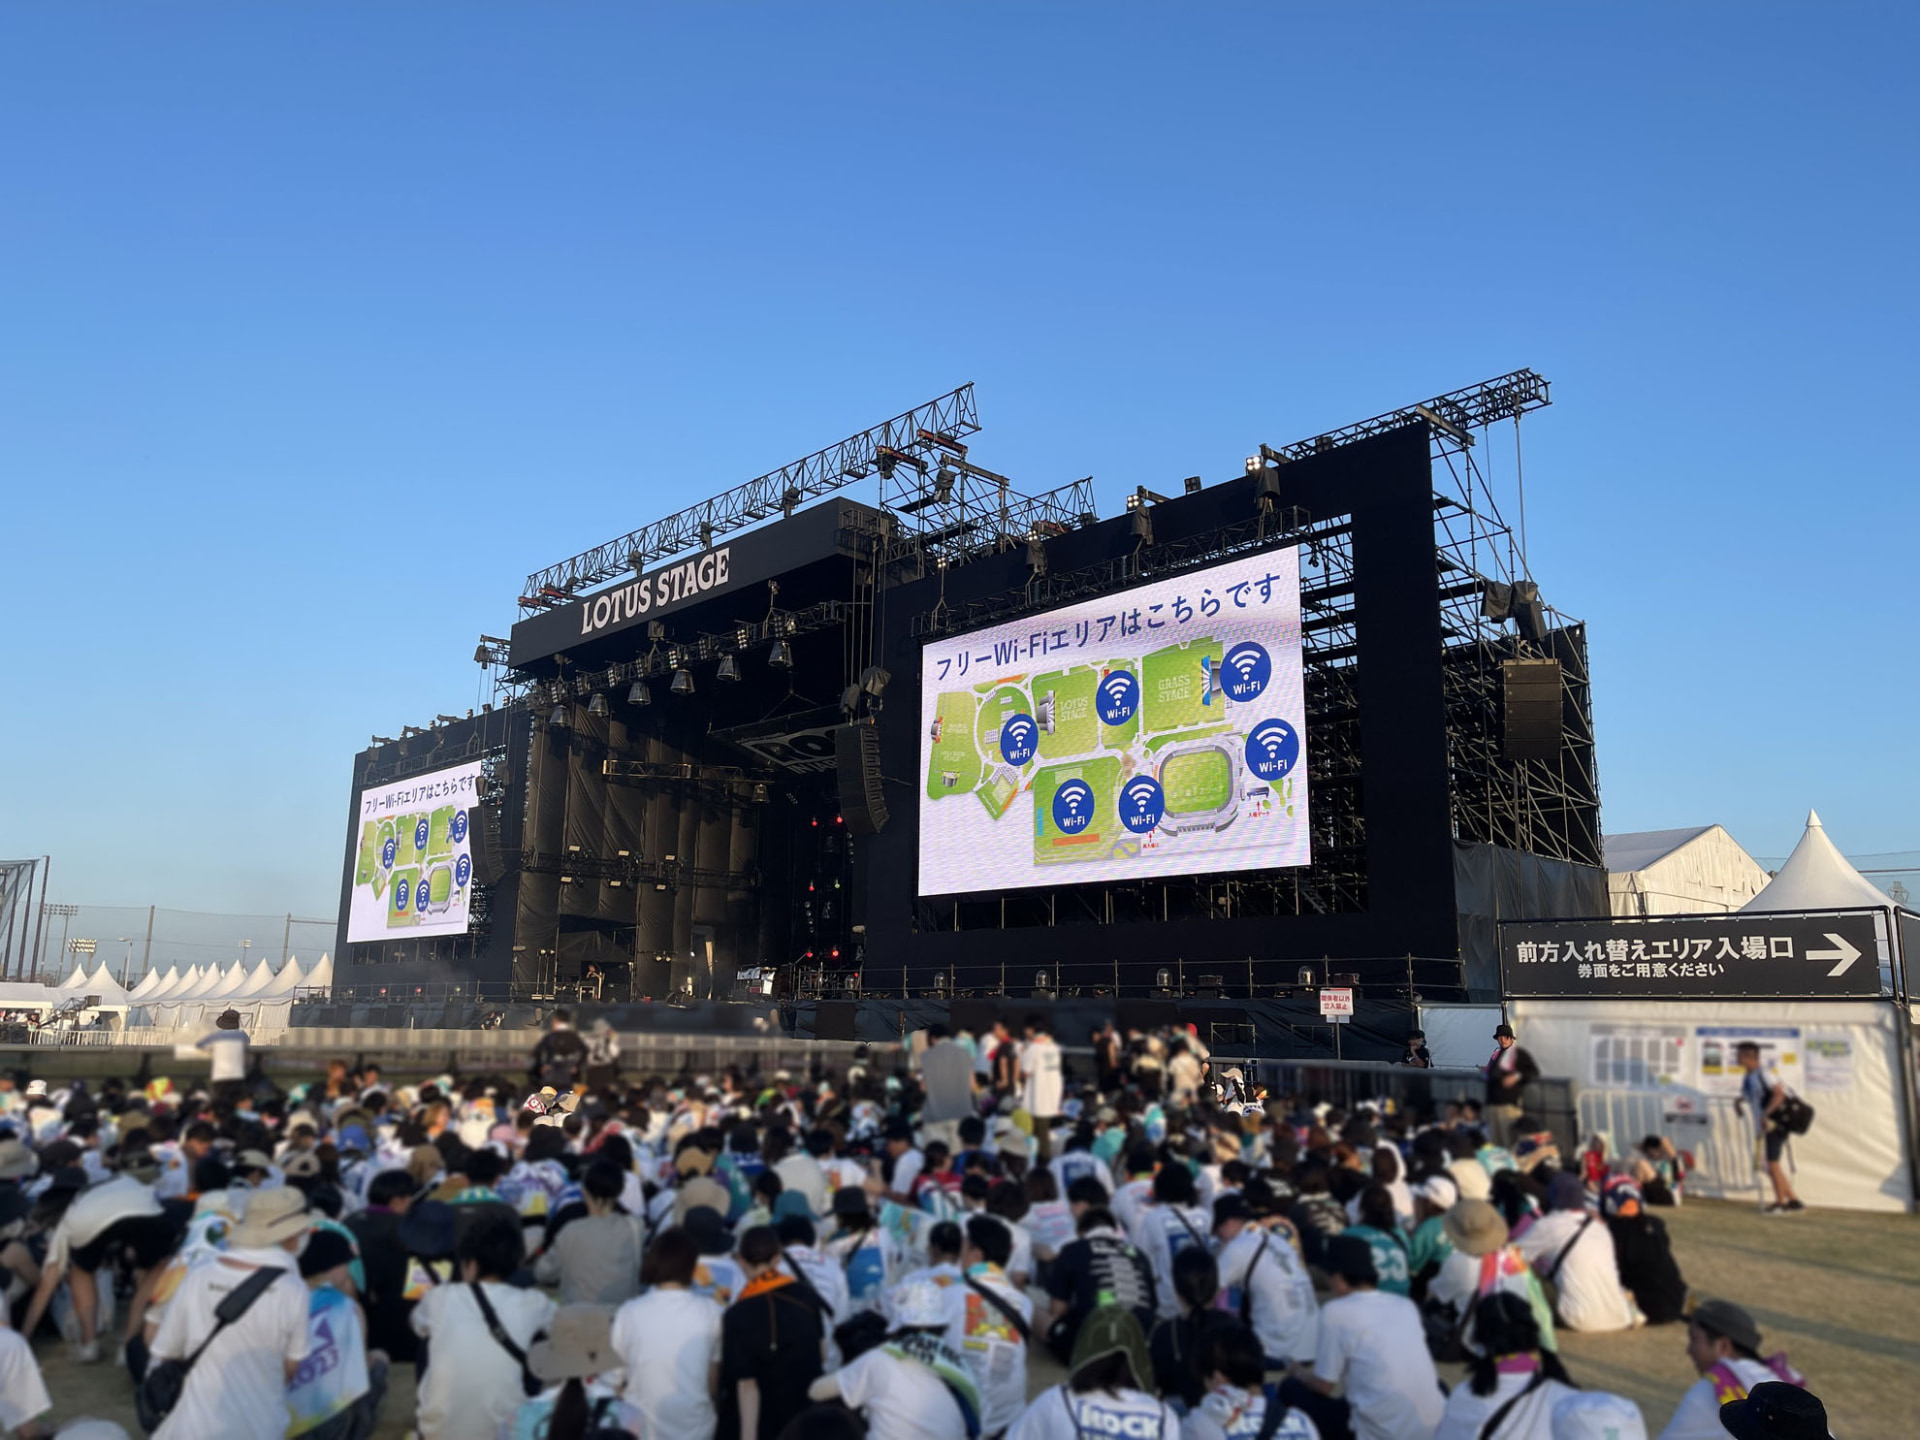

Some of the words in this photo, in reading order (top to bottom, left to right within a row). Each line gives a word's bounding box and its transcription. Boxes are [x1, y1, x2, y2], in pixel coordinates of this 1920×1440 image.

[581, 578, 651, 635] LOTUS
[656, 547, 730, 607] STAGE
[936, 572, 1281, 681] フリーWi-Fiエリアはこちらです
[1158, 675, 1191, 690] GRASS
[1233, 681, 1261, 695] Wi-Fi
[1158, 687, 1191, 703] STAGE
[1060, 708, 1087, 722] STAGE
[1107, 706, 1130, 719] Wi-Fi
[1009, 748, 1030, 760] Wi-Fi
[1259, 759, 1288, 773] Wi-Fi
[365, 773, 475, 814] フリーWi-Fiエリアはこちらです
[1063, 815, 1085, 827] Wi-Fi
[1131, 813, 1155, 826] Wi-Fi
[1517, 936, 1794, 963] 前方入れ替えエリア入場口
[1577, 962, 1725, 979] 券面をご用意ください
